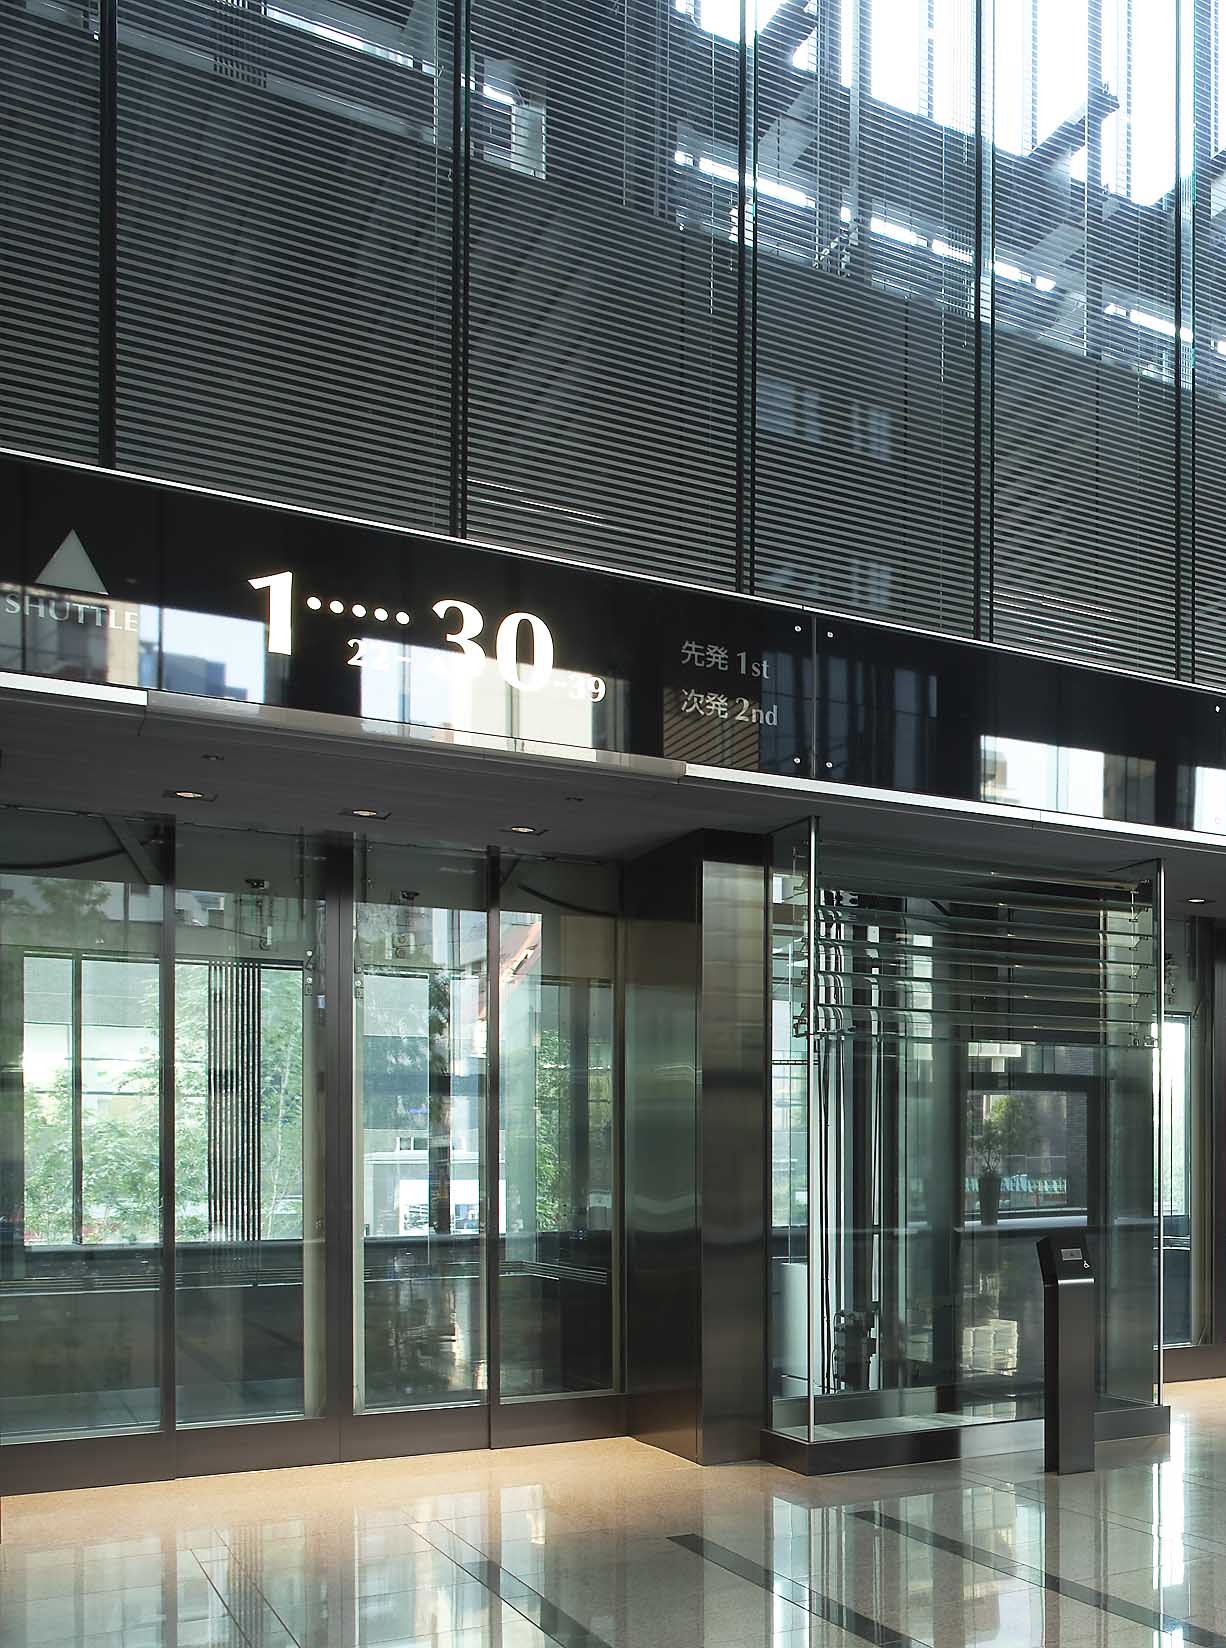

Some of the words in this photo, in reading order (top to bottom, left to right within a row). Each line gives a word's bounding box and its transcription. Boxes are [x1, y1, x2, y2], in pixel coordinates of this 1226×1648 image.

[5, 592, 138, 632] SHUTTLE
[432, 599, 553, 691] 30
[680, 639, 729, 672] 先発
[737, 650, 770, 681] 1st
[680, 687, 730, 720] 次発
[735, 696, 779, 727] 2nd
